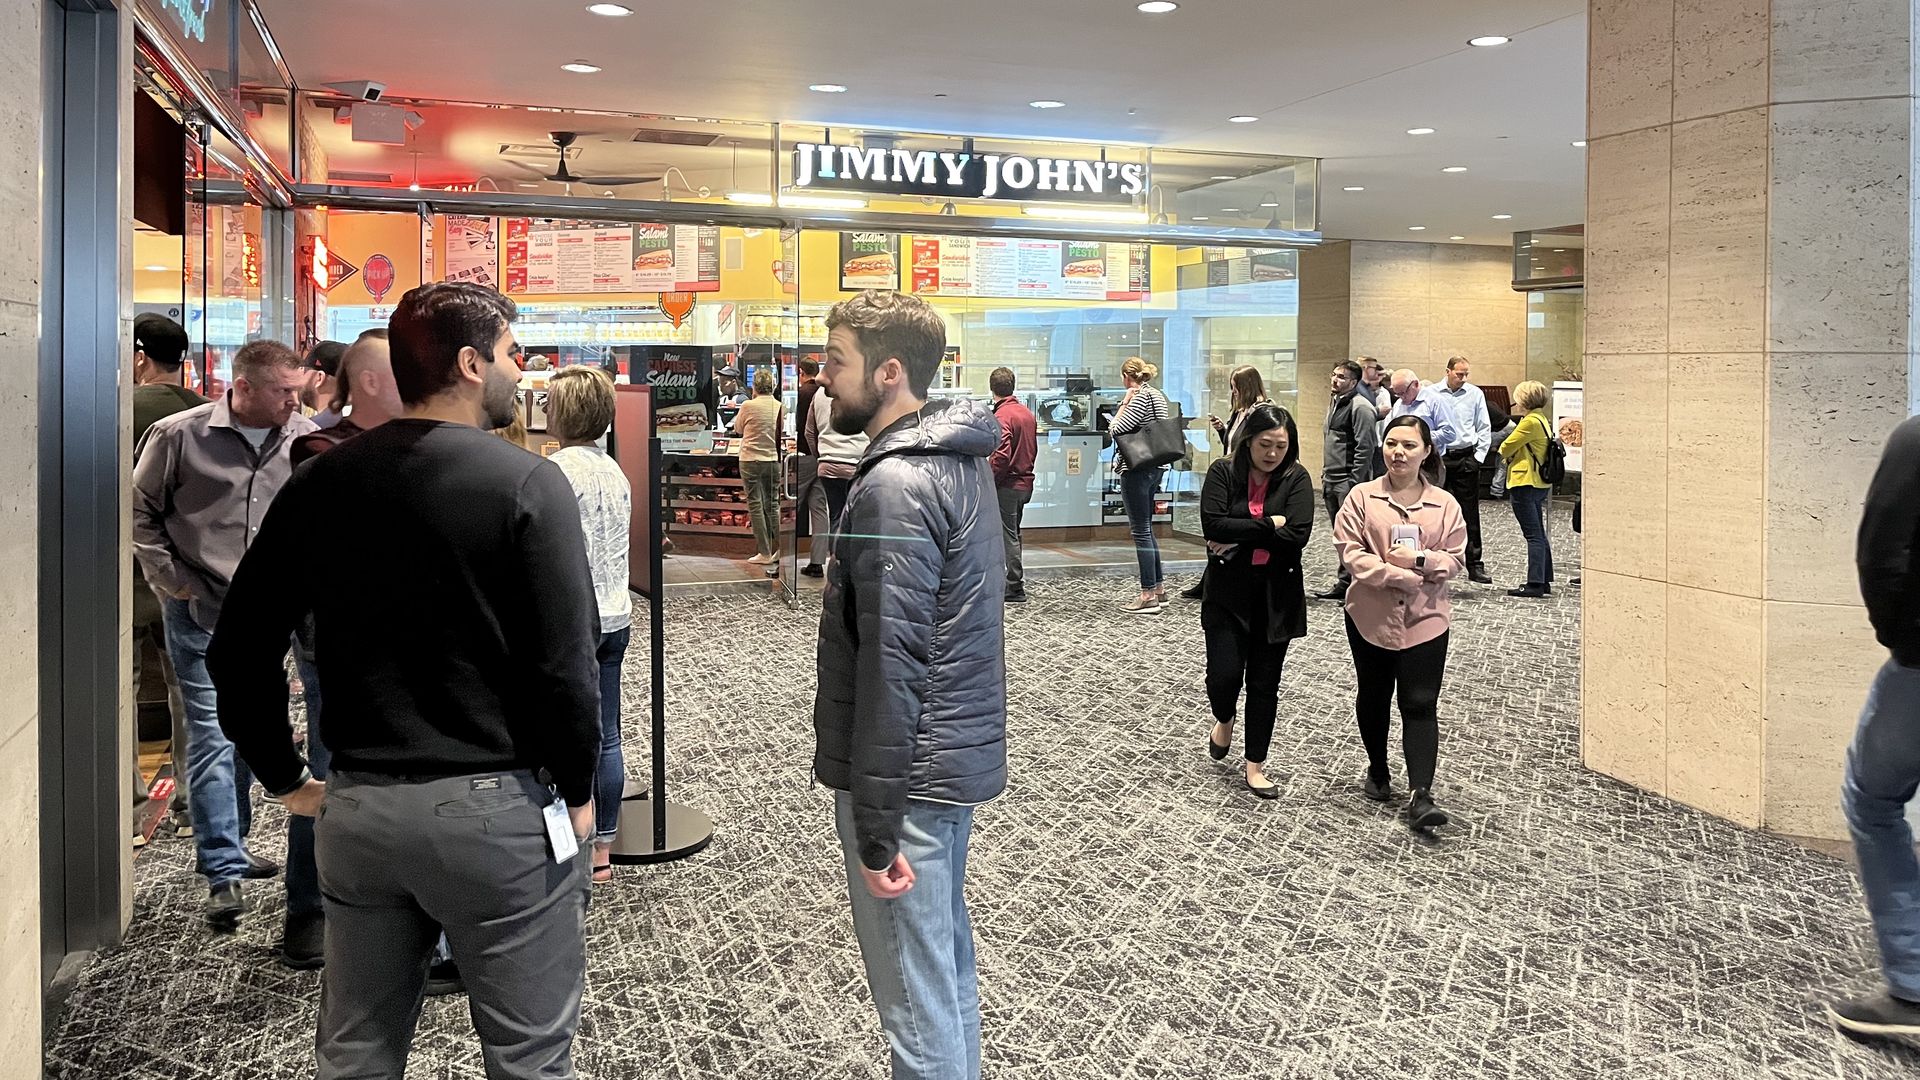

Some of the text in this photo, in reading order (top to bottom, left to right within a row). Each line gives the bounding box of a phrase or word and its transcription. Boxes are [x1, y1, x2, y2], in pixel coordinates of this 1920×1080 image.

[796, 143, 1143, 197] JIMMY JOHN'S
[639, 226, 669, 240] Salami
[852, 232, 887, 243] Salami
[639, 239, 668, 249] PESTO
[852, 241, 887, 252] PESTO
[1068, 247, 1099, 257] PESTO
[663, 353, 680, 362] New
[647, 360, 697, 372] CAPRESE
[646, 369, 698, 387] Salami
[656, 387, 697, 400] ESTO
